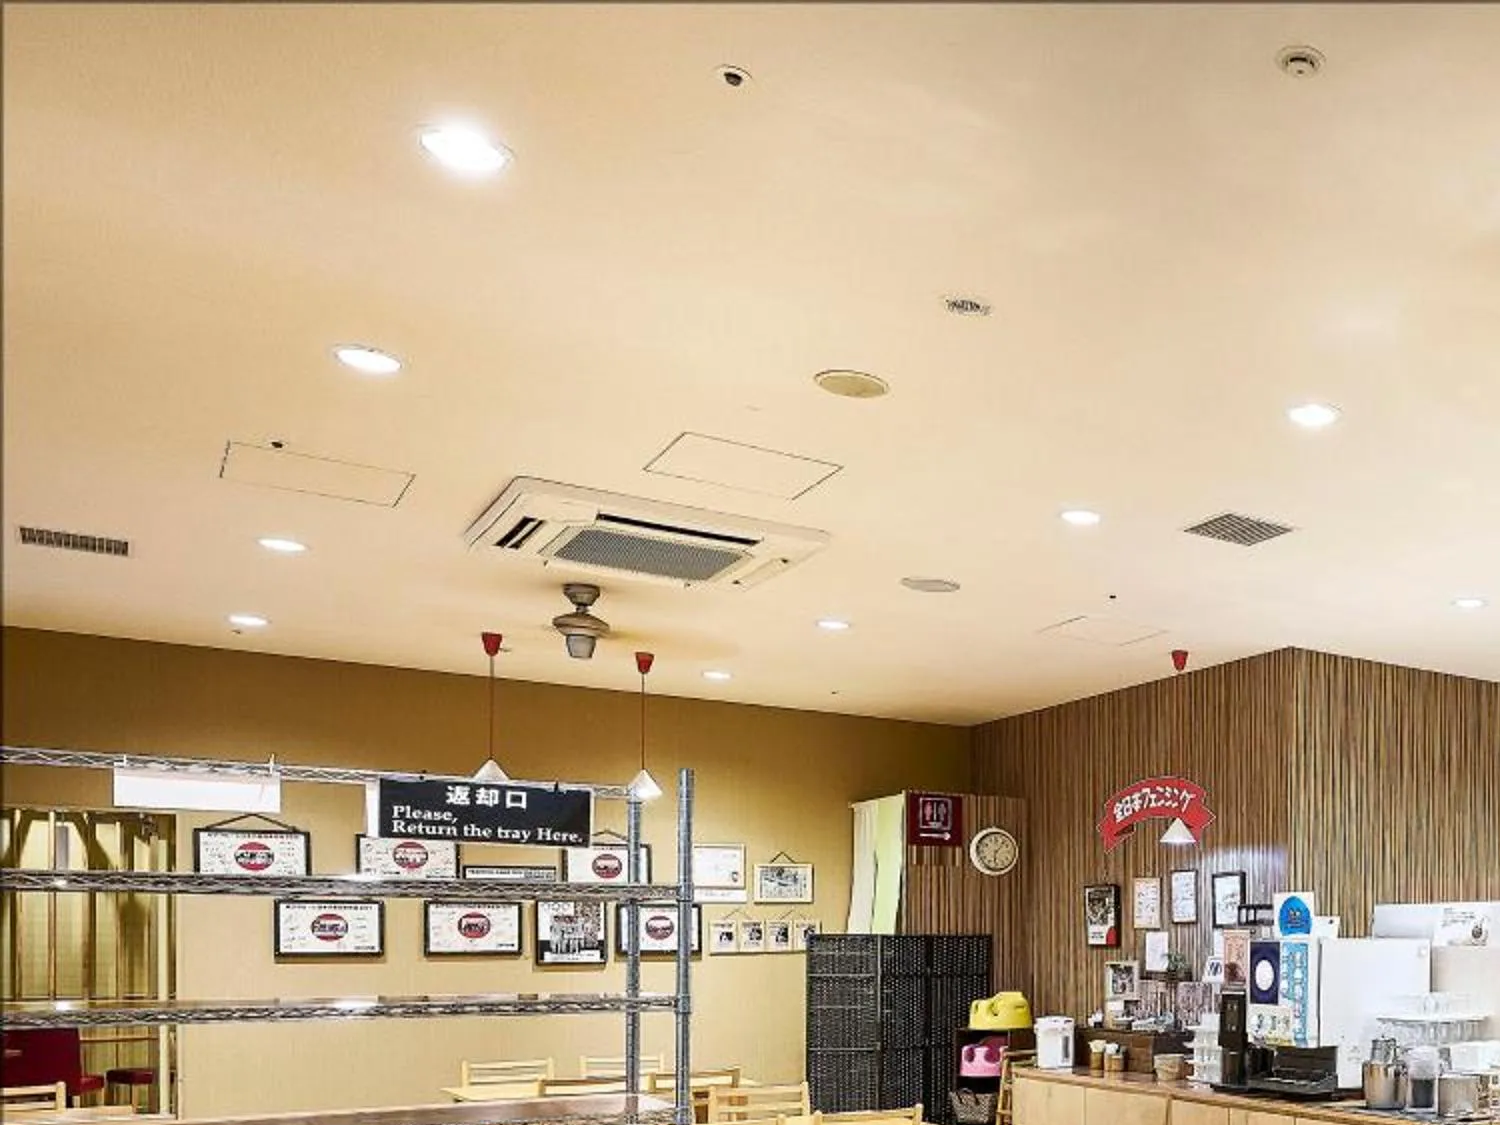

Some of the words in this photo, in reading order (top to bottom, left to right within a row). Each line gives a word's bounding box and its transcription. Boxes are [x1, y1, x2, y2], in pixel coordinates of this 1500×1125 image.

[446, 785, 527, 809] 返却口
[391, 805, 459, 824] Please,
[391, 819, 457, 837] Return
[463, 823, 493, 839] the
[497, 826, 532, 843] tray
[537, 827, 584, 844] Here.
